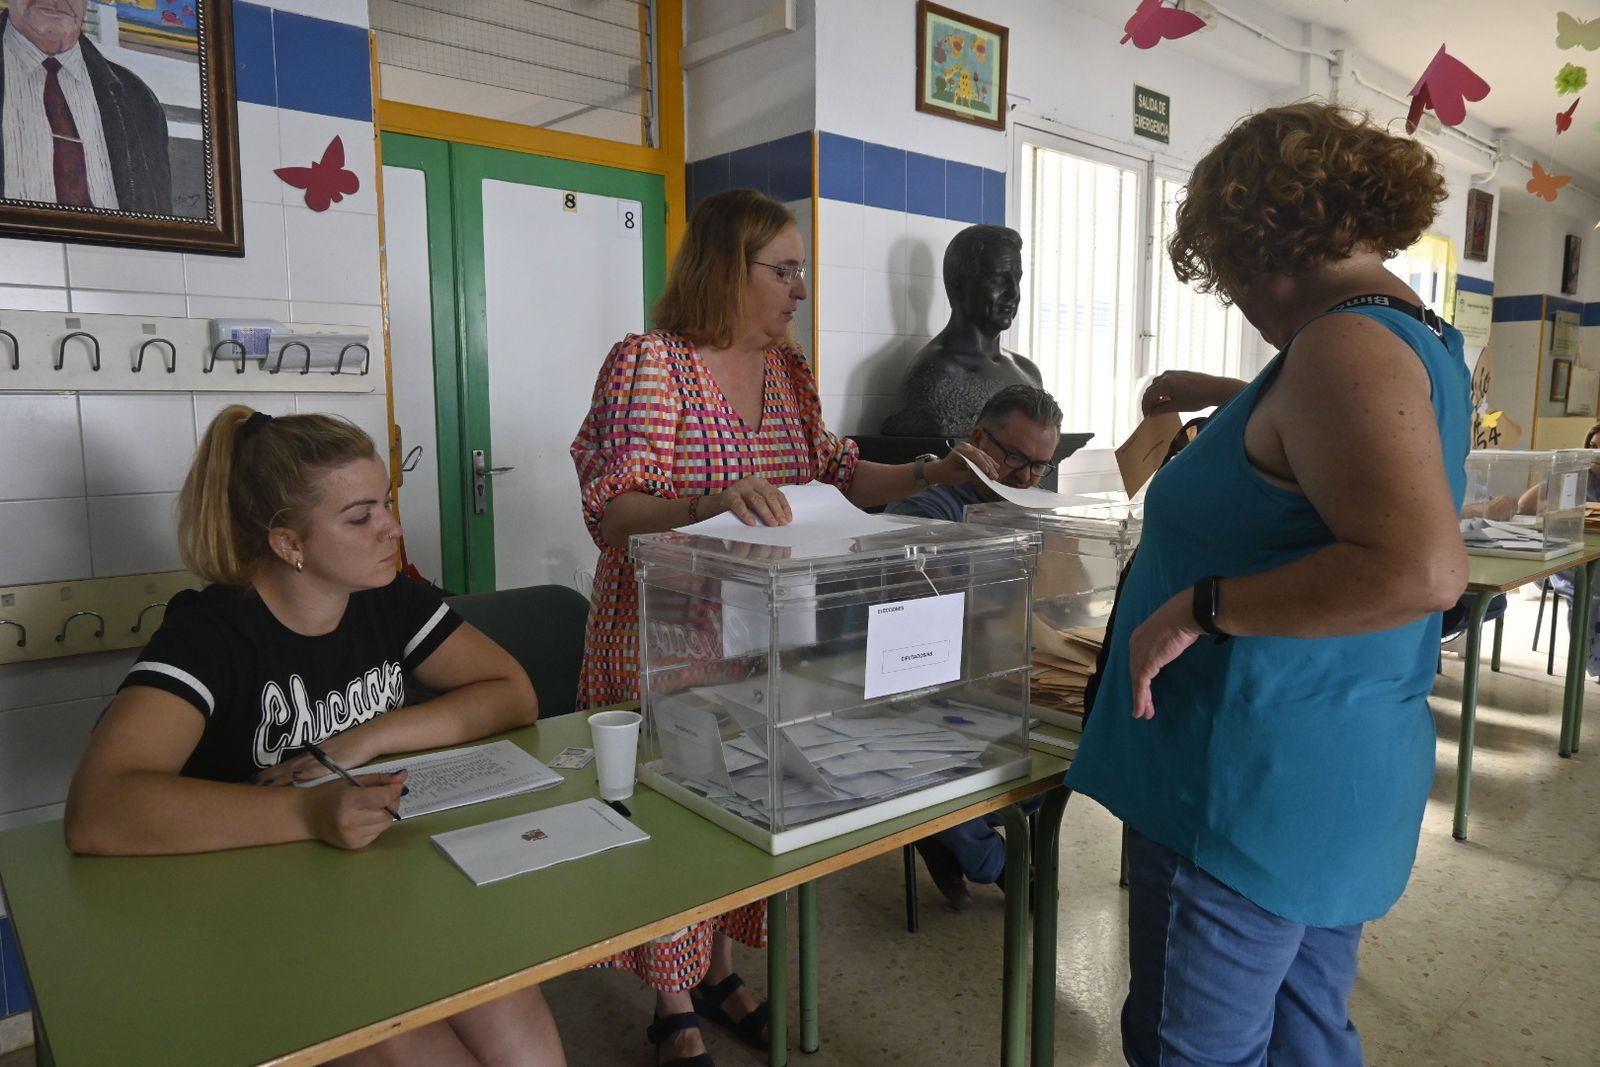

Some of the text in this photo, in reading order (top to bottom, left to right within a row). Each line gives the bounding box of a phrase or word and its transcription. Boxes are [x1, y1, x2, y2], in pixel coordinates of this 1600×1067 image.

[1138, 94, 1166, 116] SALIDA DE
[1135, 113, 1168, 137] EMERGENCIA
[564, 193, 576, 209] 8
[624, 211, 635, 229] 8
[877, 605, 904, 614] ELECCIONES
